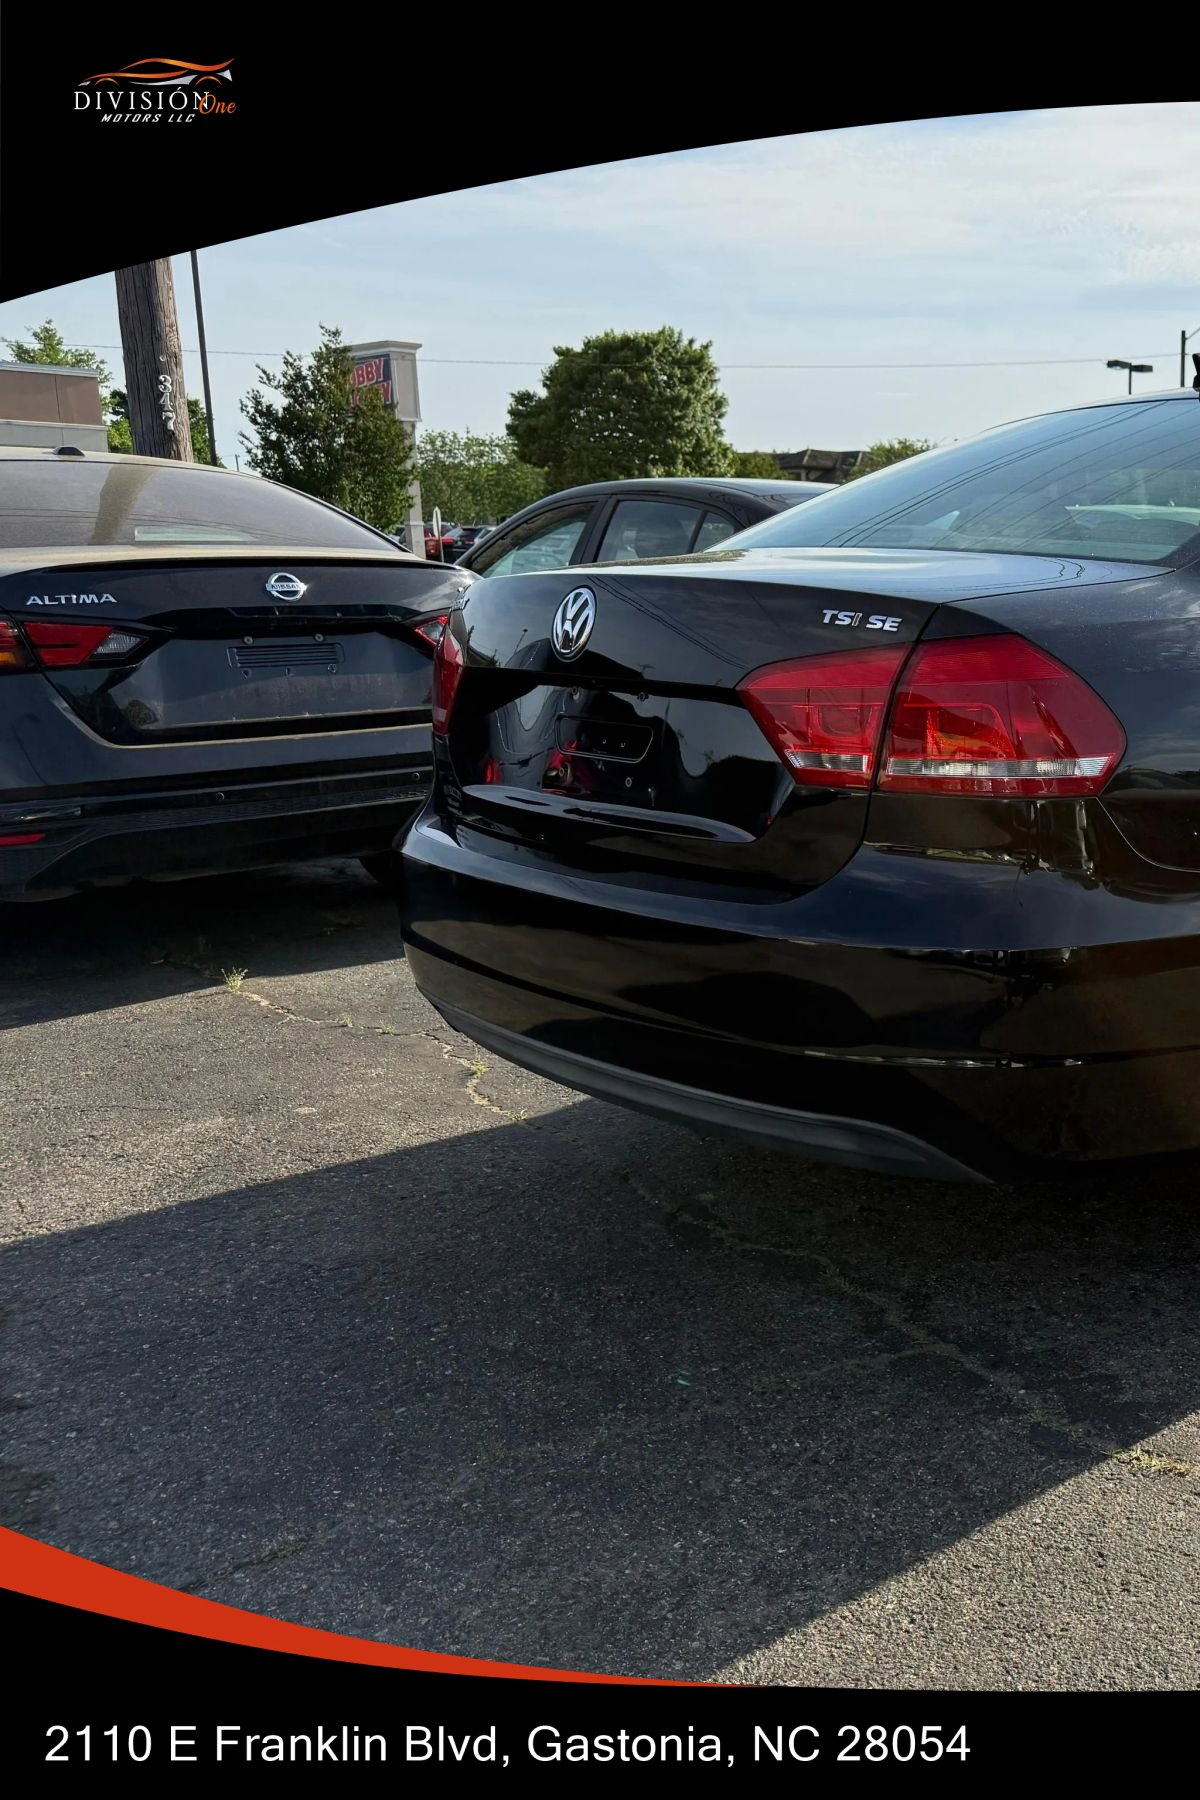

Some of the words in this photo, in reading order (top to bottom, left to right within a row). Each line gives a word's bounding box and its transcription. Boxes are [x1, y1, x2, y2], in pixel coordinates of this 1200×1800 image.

[350, 358, 384, 388] OBBY
[158, 374, 176, 431] 347
[26, 593, 118, 606] ALTIMA
[822, 609, 863, 627] TSI
[865, 614, 903, 632] SE
